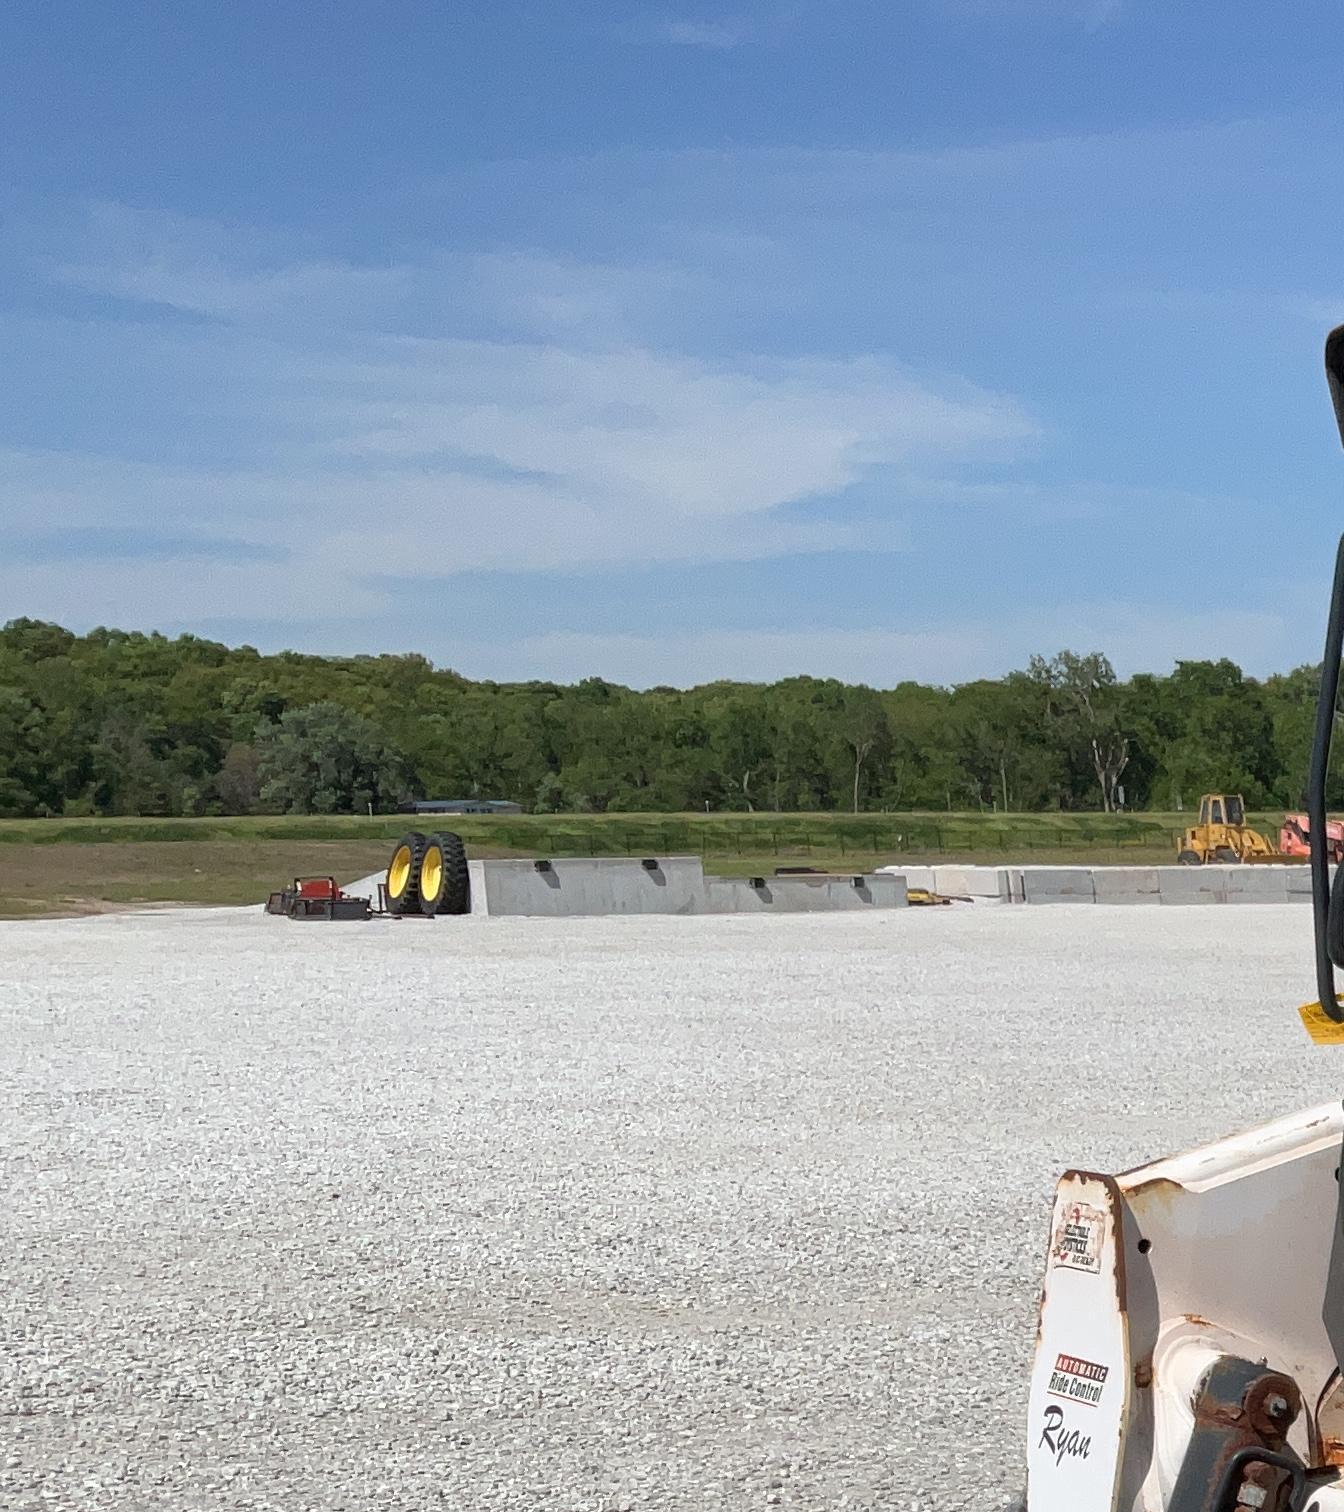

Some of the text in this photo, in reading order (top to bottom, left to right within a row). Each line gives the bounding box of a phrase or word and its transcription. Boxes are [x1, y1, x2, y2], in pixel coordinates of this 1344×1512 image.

[1055, 1357, 1106, 1382] AUTOMATIC
[1048, 1372, 1103, 1402] Ride Control
[1038, 1405, 1091, 1467] Ryan
